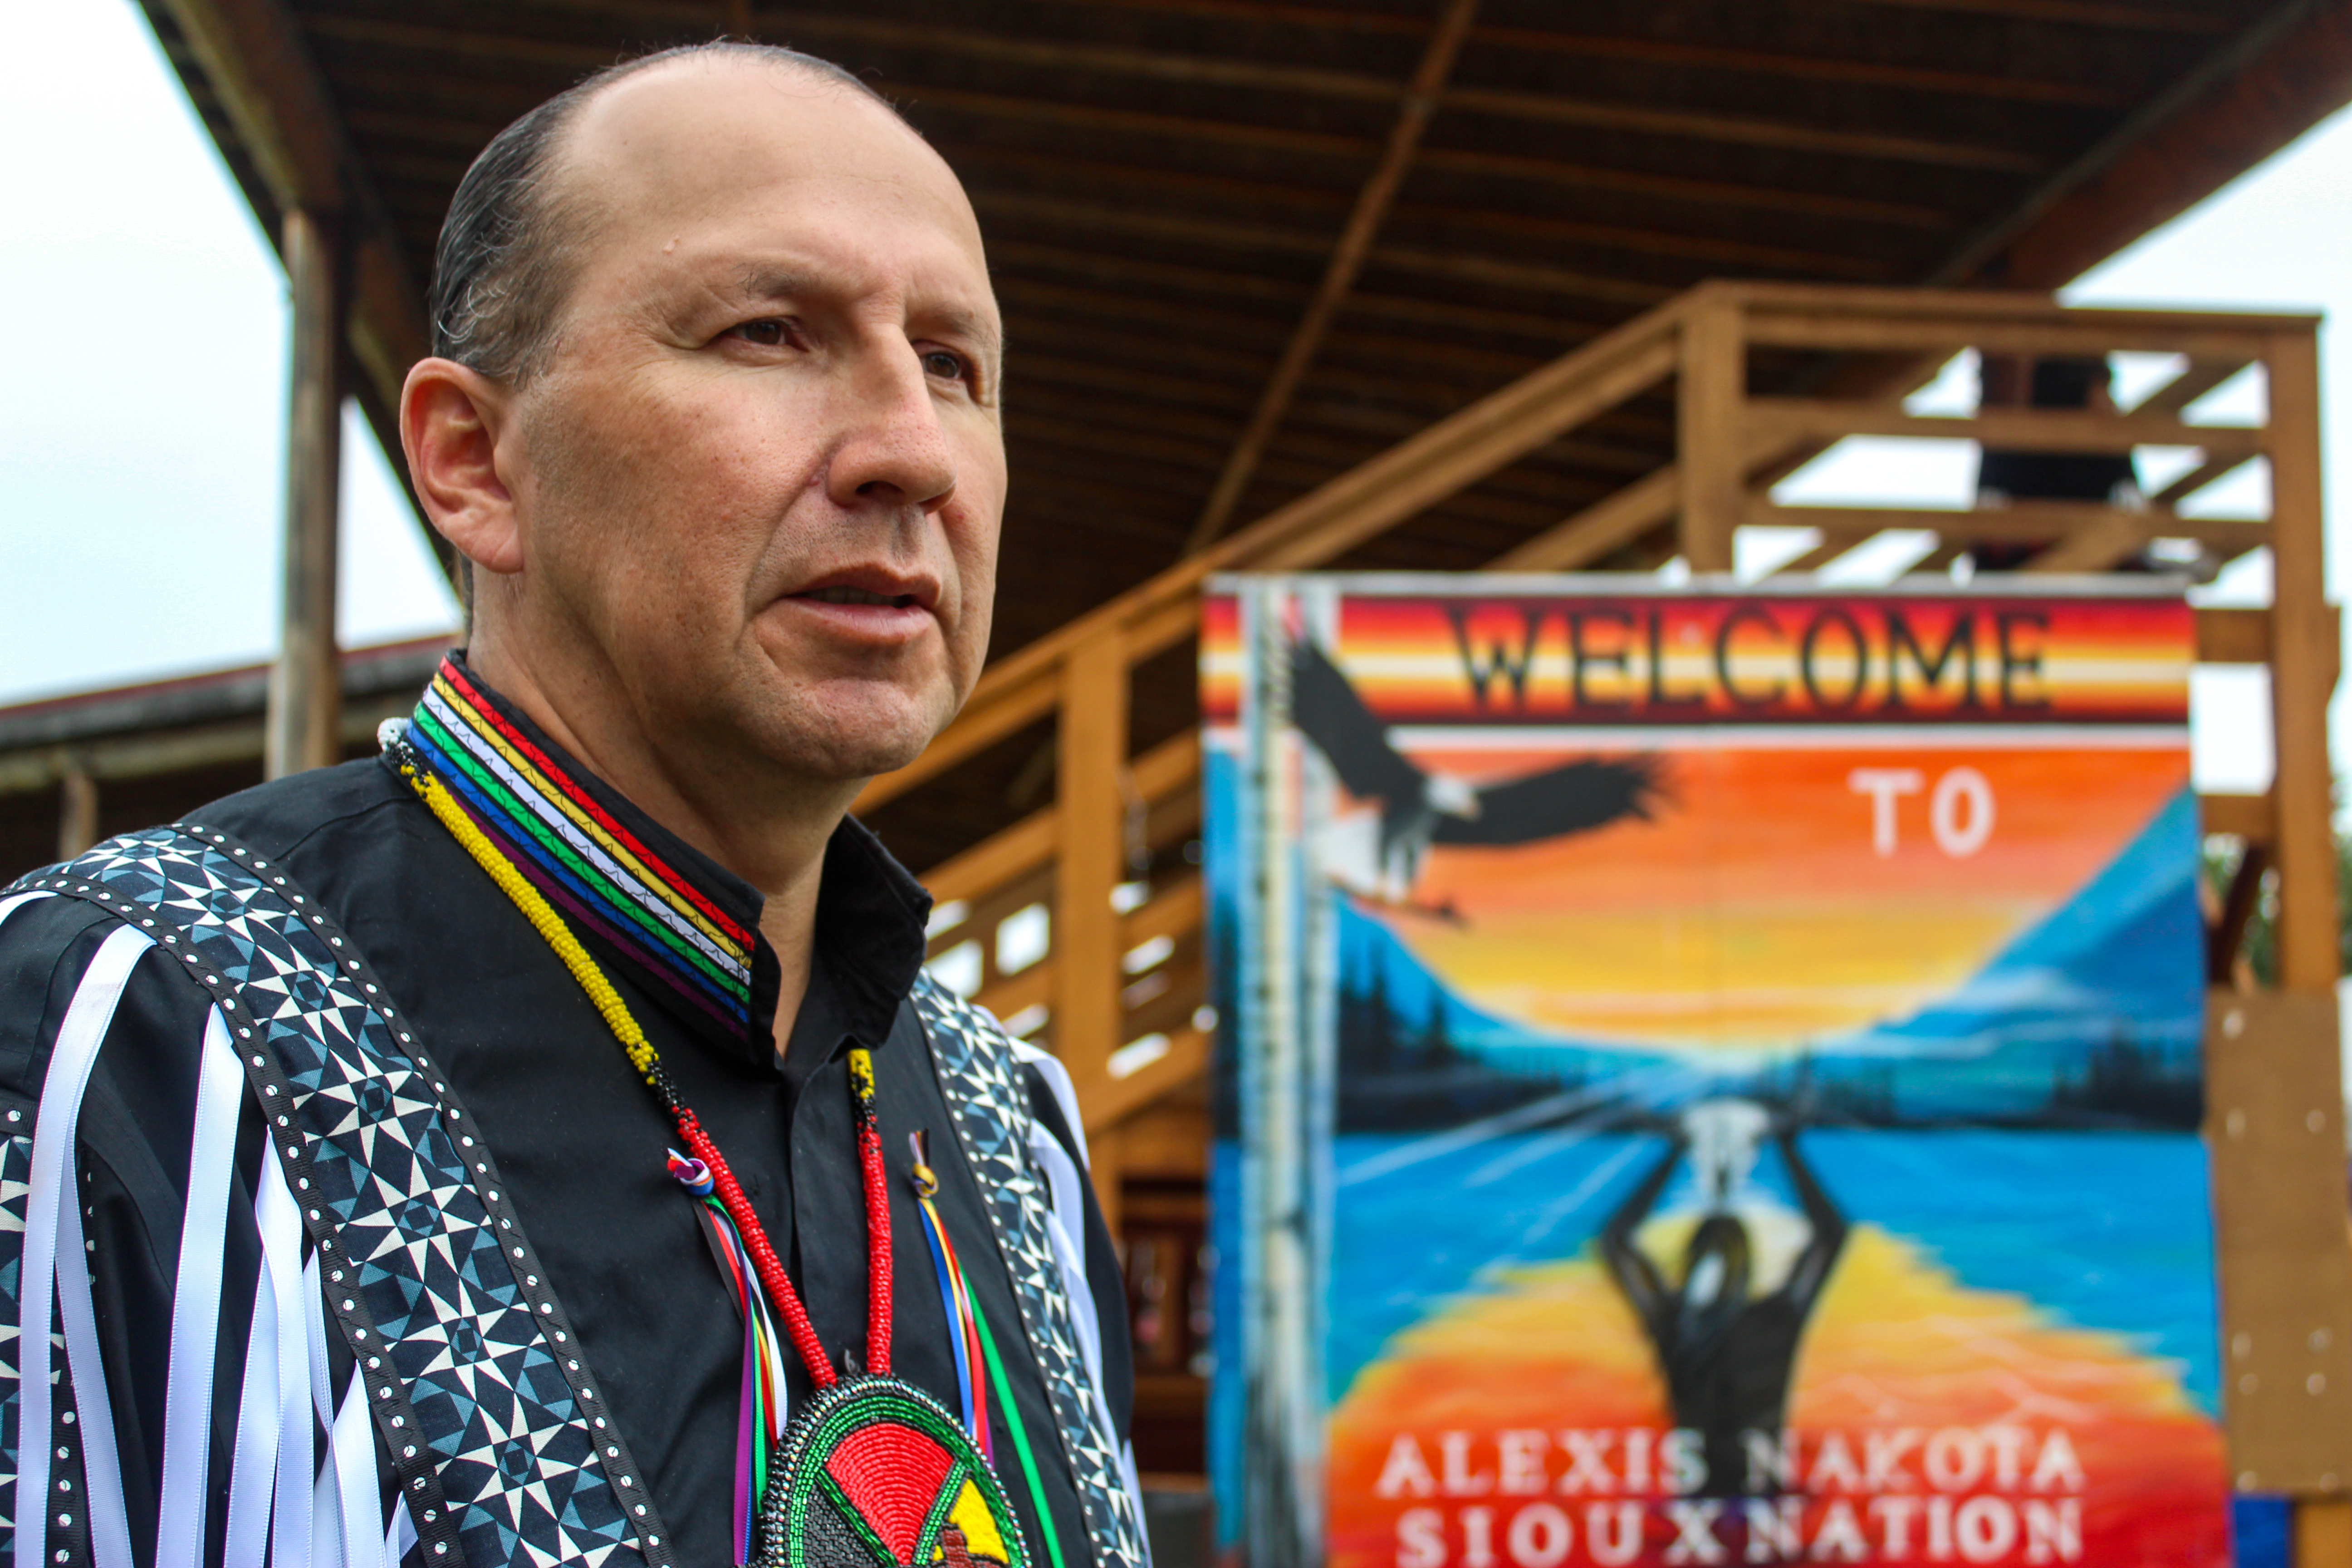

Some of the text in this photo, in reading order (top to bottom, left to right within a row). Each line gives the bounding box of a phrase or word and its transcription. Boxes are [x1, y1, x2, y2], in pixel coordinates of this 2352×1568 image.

[1445, 608, 2053, 709] WELCOME
[1847, 766, 1995, 858] TO
[1374, 1425, 2085, 1497] ALEXIS NAKOTA
[1396, 1495, 2084, 1568] SIOUX NATION
